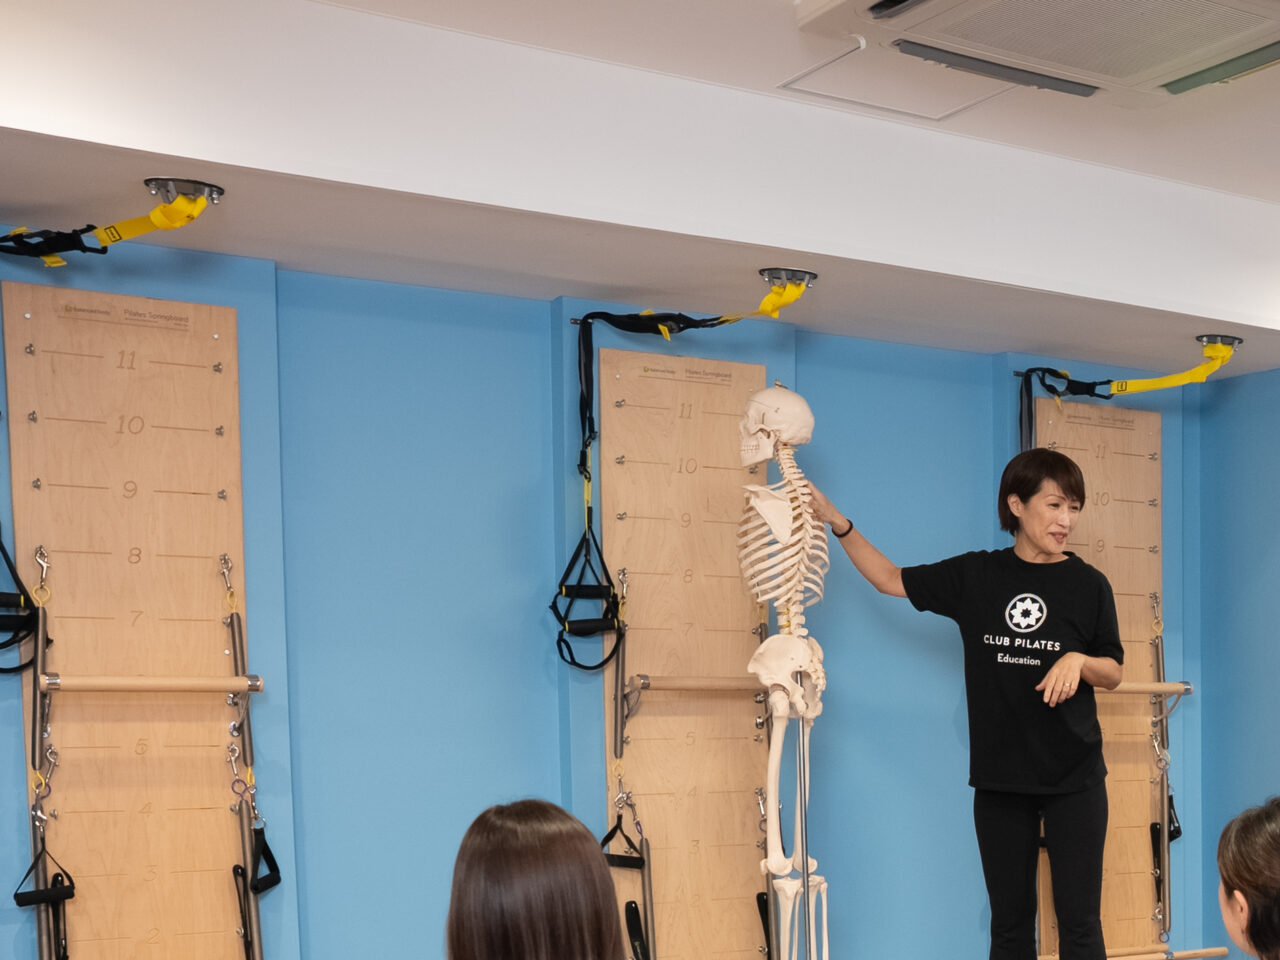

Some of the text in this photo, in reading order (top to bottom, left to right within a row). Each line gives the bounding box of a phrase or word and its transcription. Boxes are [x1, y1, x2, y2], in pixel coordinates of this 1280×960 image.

[116, 350, 136, 370] 11
[679, 402, 693, 420] 11
[115, 414, 145, 435] 10
[1095, 444, 1106, 459] 11
[676, 457, 698, 474] 10
[122, 480, 138, 499] 9
[1092, 492, 1110, 507] 10
[680, 512, 692, 528] 9
[1095, 538, 1105, 553] 9
[127, 547, 142, 565] 8
[682, 568, 693, 583] 8
[130, 609, 144, 627] 7
[684, 622, 694, 637] 7
[983, 634, 1061, 651] CLUB PILATES
[997, 653, 1041, 666] Education
[134, 738, 149, 756] 5
[685, 731, 696, 746] 5
[687, 785, 697, 799] 4
[138, 801, 153, 818] 4
